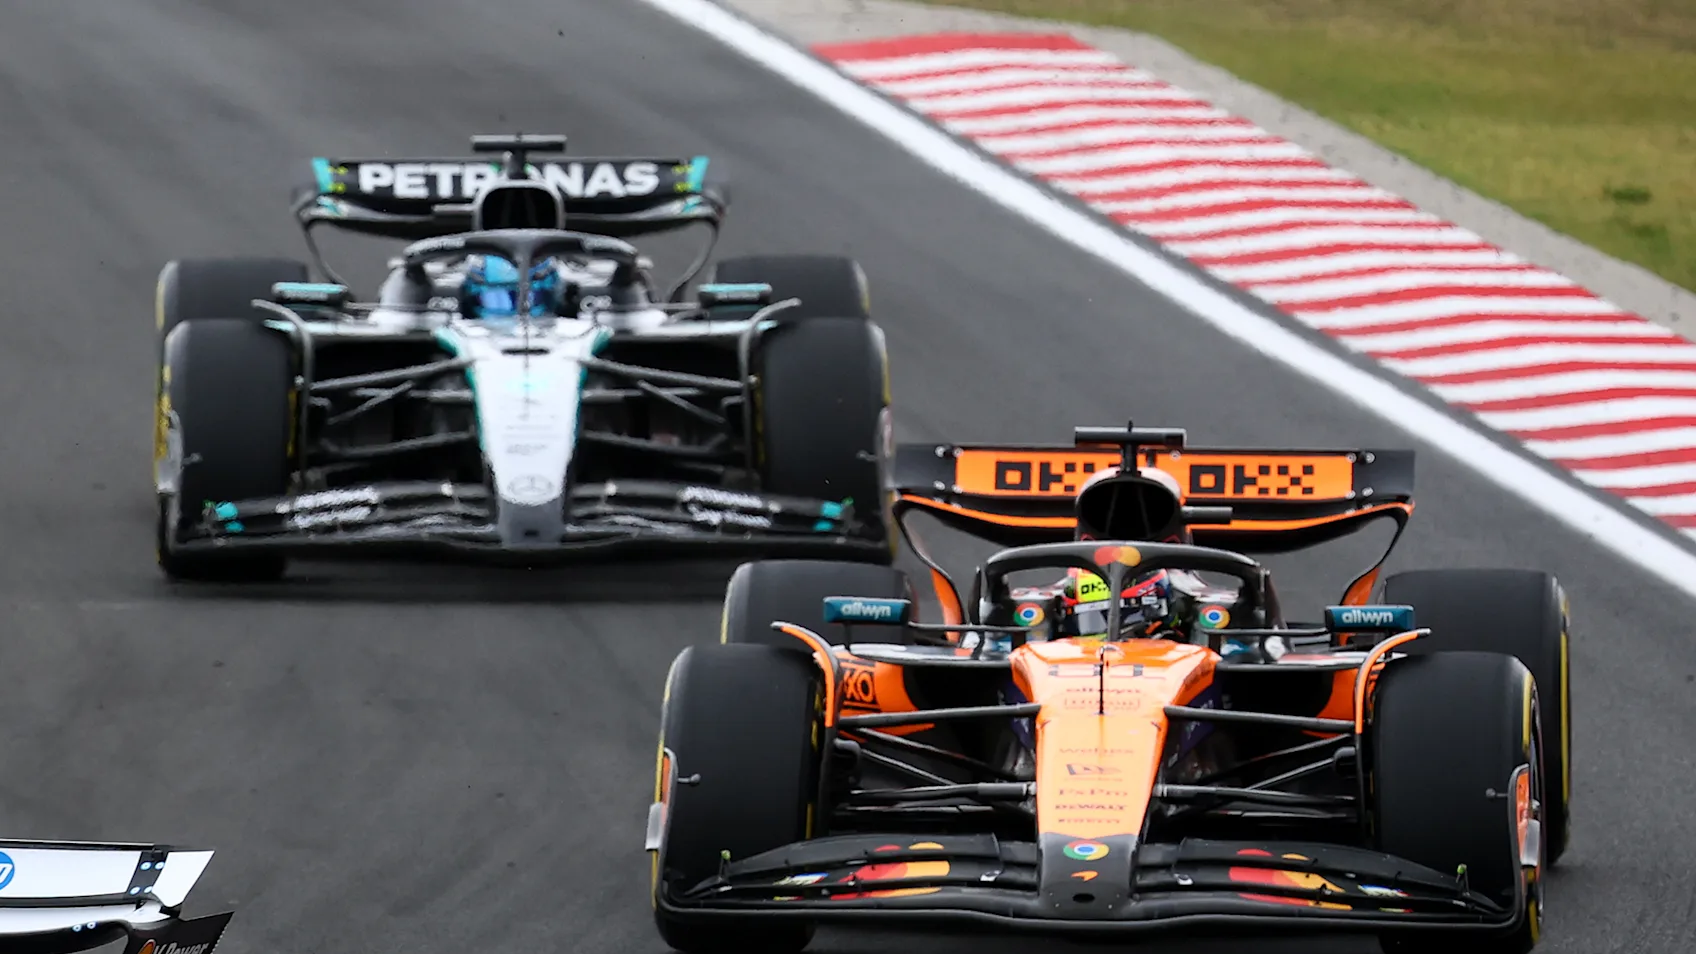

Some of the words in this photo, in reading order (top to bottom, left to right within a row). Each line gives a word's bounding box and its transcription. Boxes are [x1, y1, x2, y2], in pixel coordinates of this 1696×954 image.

[358, 162, 661, 198] PETRNAS
[995, 460, 1119, 492] OK
[1189, 463, 1314, 495] OKX
[1341, 606, 1395, 624] allwyn
